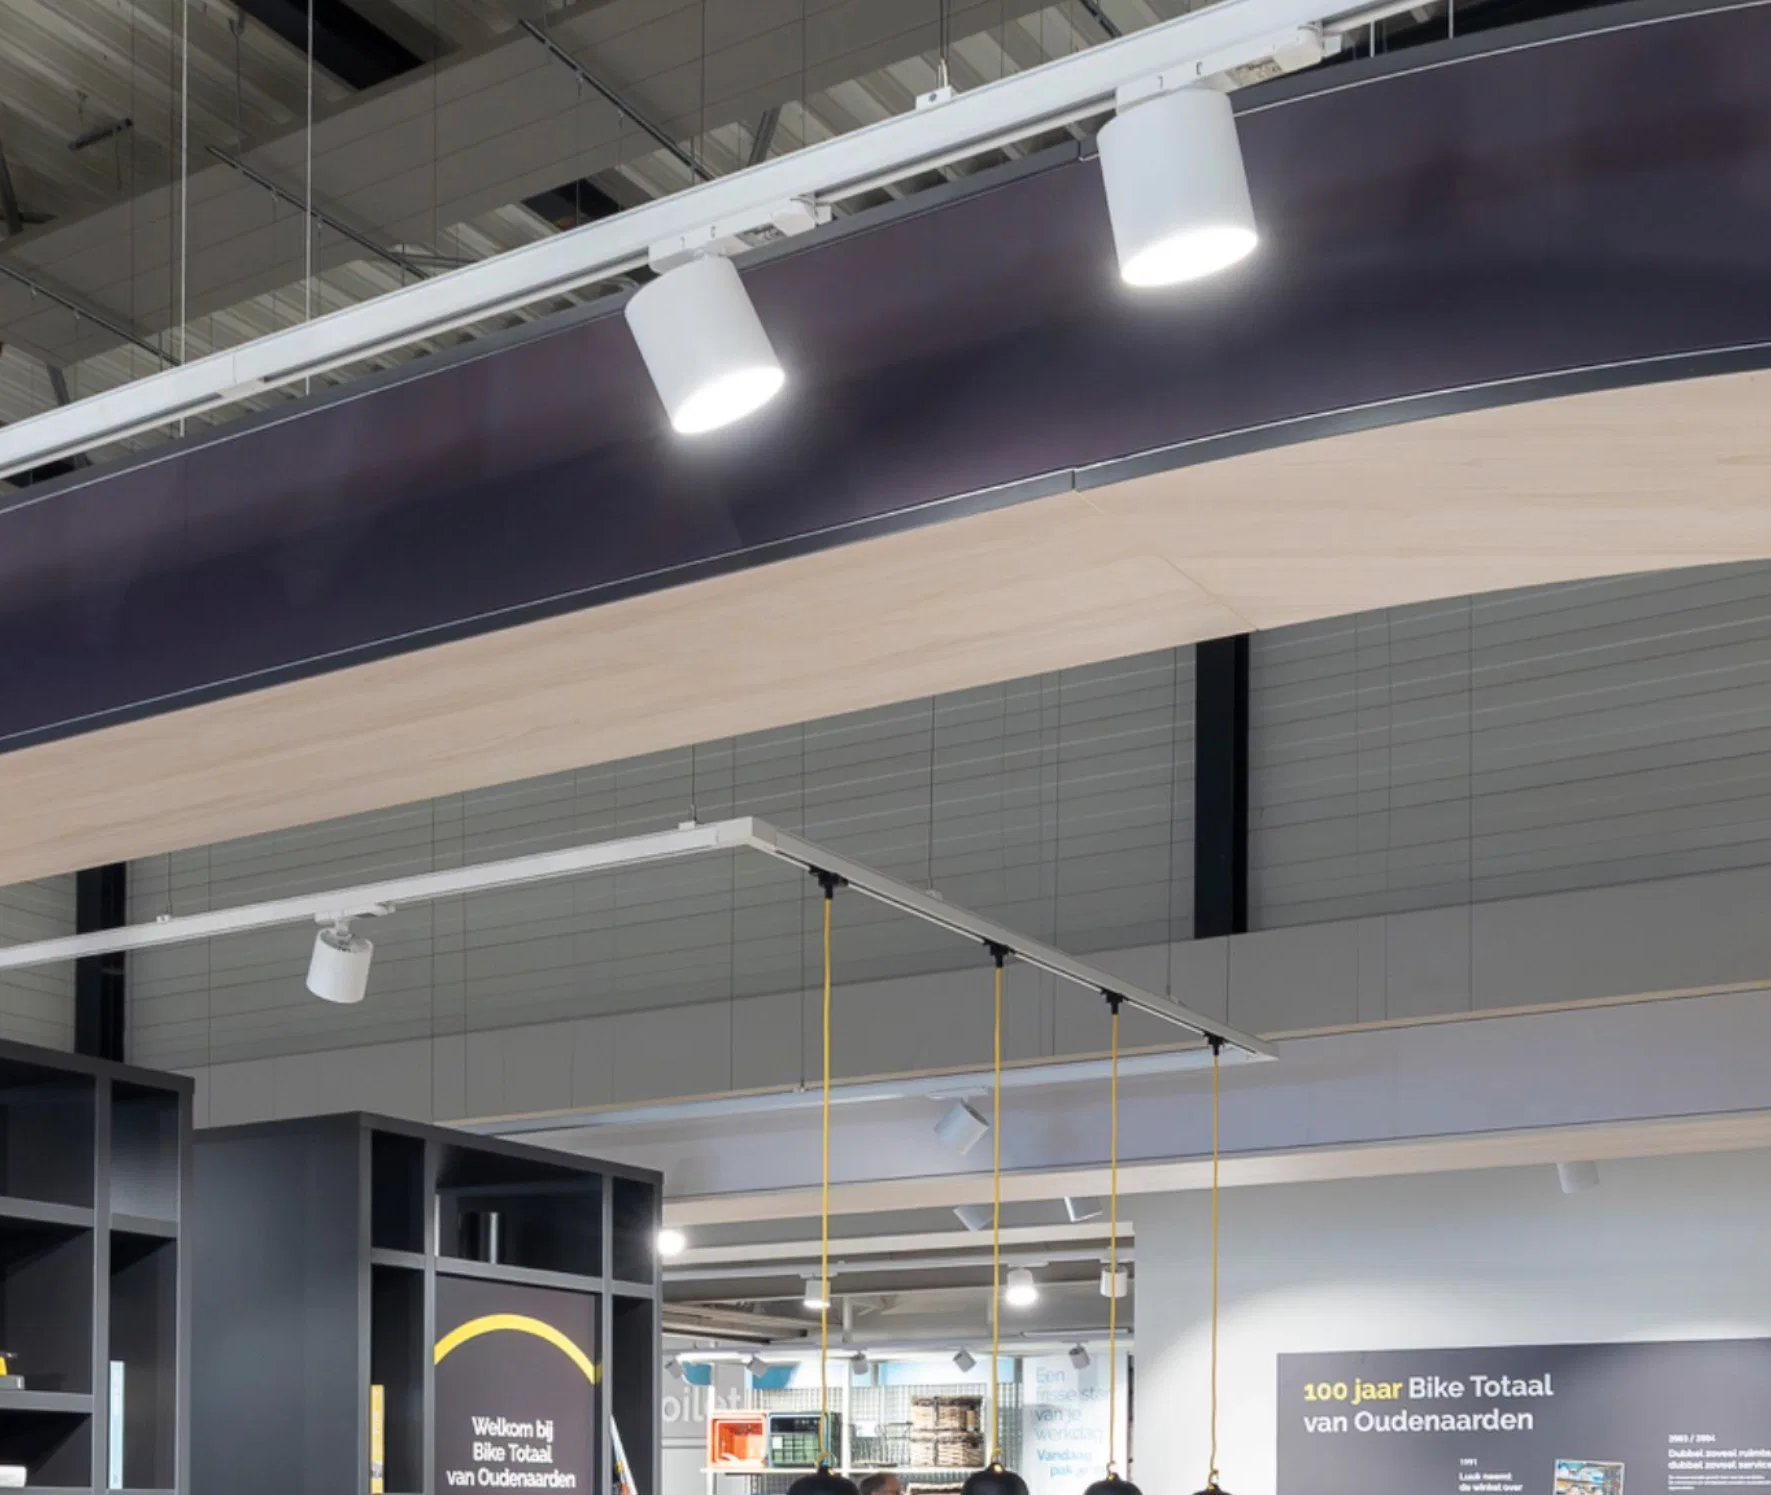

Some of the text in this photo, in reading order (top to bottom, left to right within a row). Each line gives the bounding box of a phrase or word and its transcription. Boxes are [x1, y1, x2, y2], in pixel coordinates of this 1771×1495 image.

[1303, 1374, 1554, 1405] 100 jaar Bike Totaal
[1035, 1409, 1063, 1421] van
[1303, 1408, 1534, 1433] van Oudenaarden
[471, 1416, 554, 1442] Welkom bij
[473, 1441, 554, 1463] Bike Totaal
[446, 1467, 576, 1488] van Oudenaarden
